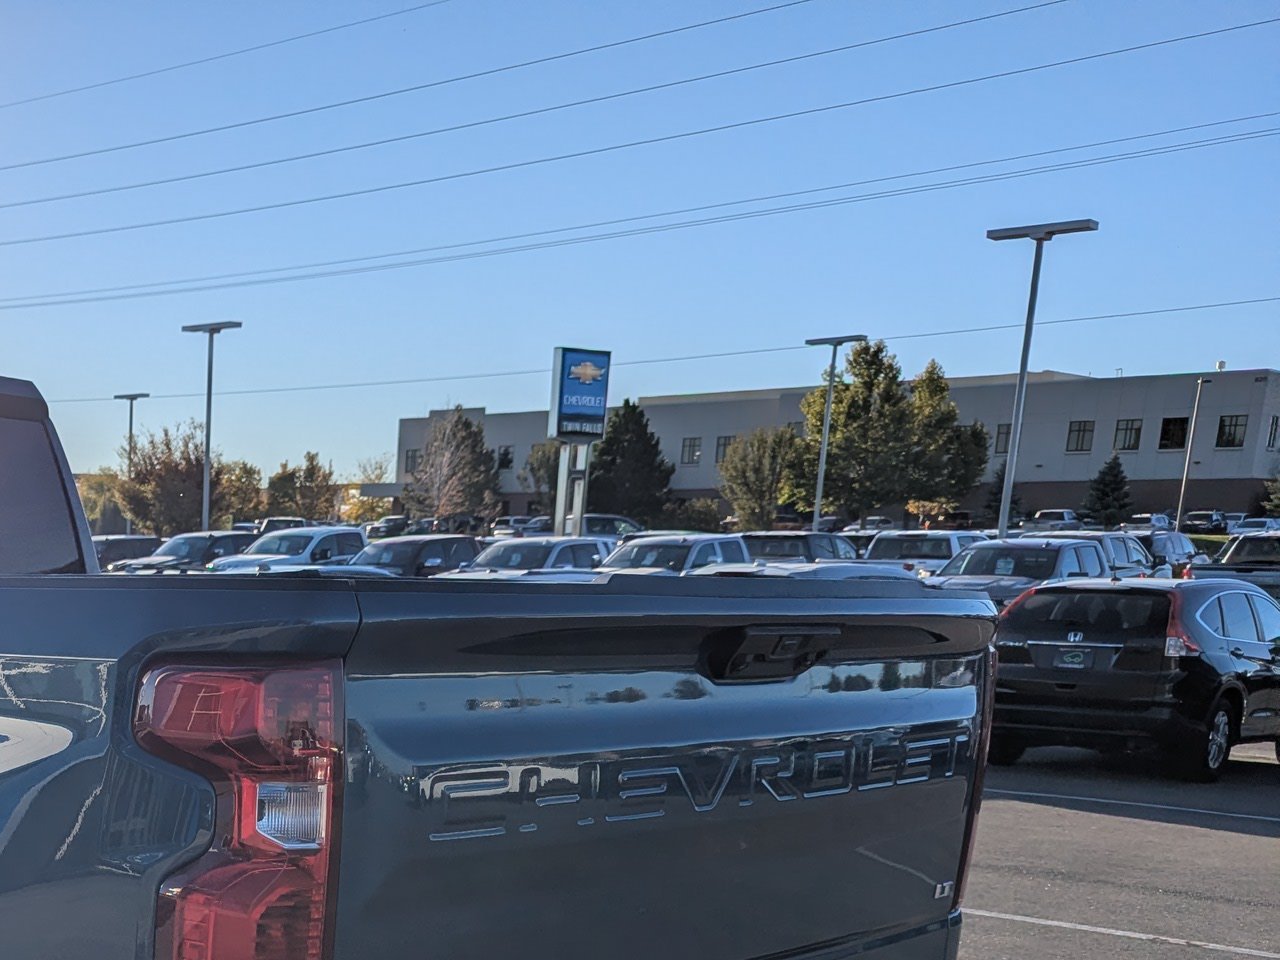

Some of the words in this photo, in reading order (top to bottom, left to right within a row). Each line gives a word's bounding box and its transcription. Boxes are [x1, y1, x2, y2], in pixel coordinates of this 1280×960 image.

[563, 396, 604, 407] CHEVROLET
[562, 422, 580, 432] TWIN
[582, 423, 602, 433] FALLS
[420, 730, 969, 842] CHEVROLET
[934, 880, 954, 899] LT
